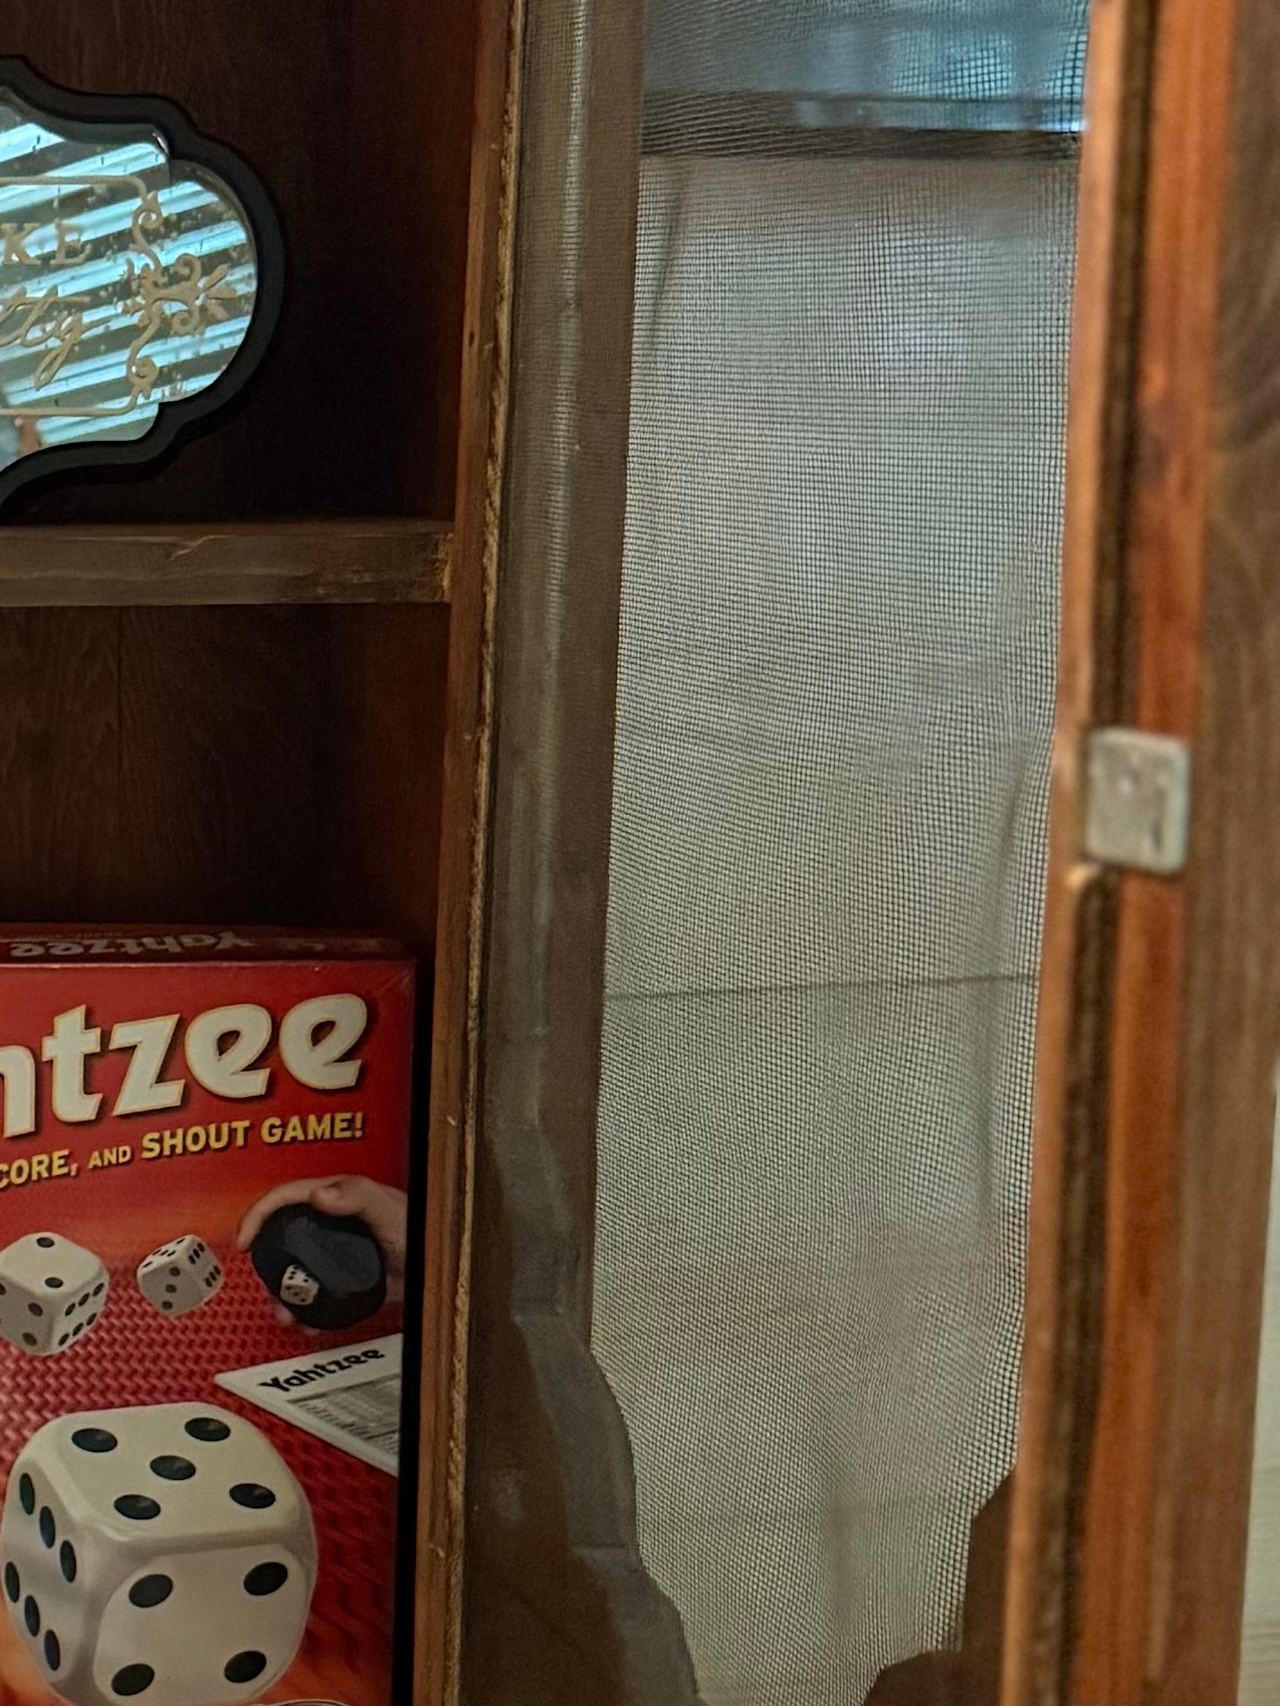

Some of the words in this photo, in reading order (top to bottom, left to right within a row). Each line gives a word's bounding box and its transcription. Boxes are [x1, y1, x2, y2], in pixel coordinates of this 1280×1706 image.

[87, 1145, 132, 1169] AND
[141, 1120, 251, 1159] SHOUT
[260, 1111, 364, 1144] GAME!
[257, 1348, 386, 1392] Yahtzee
